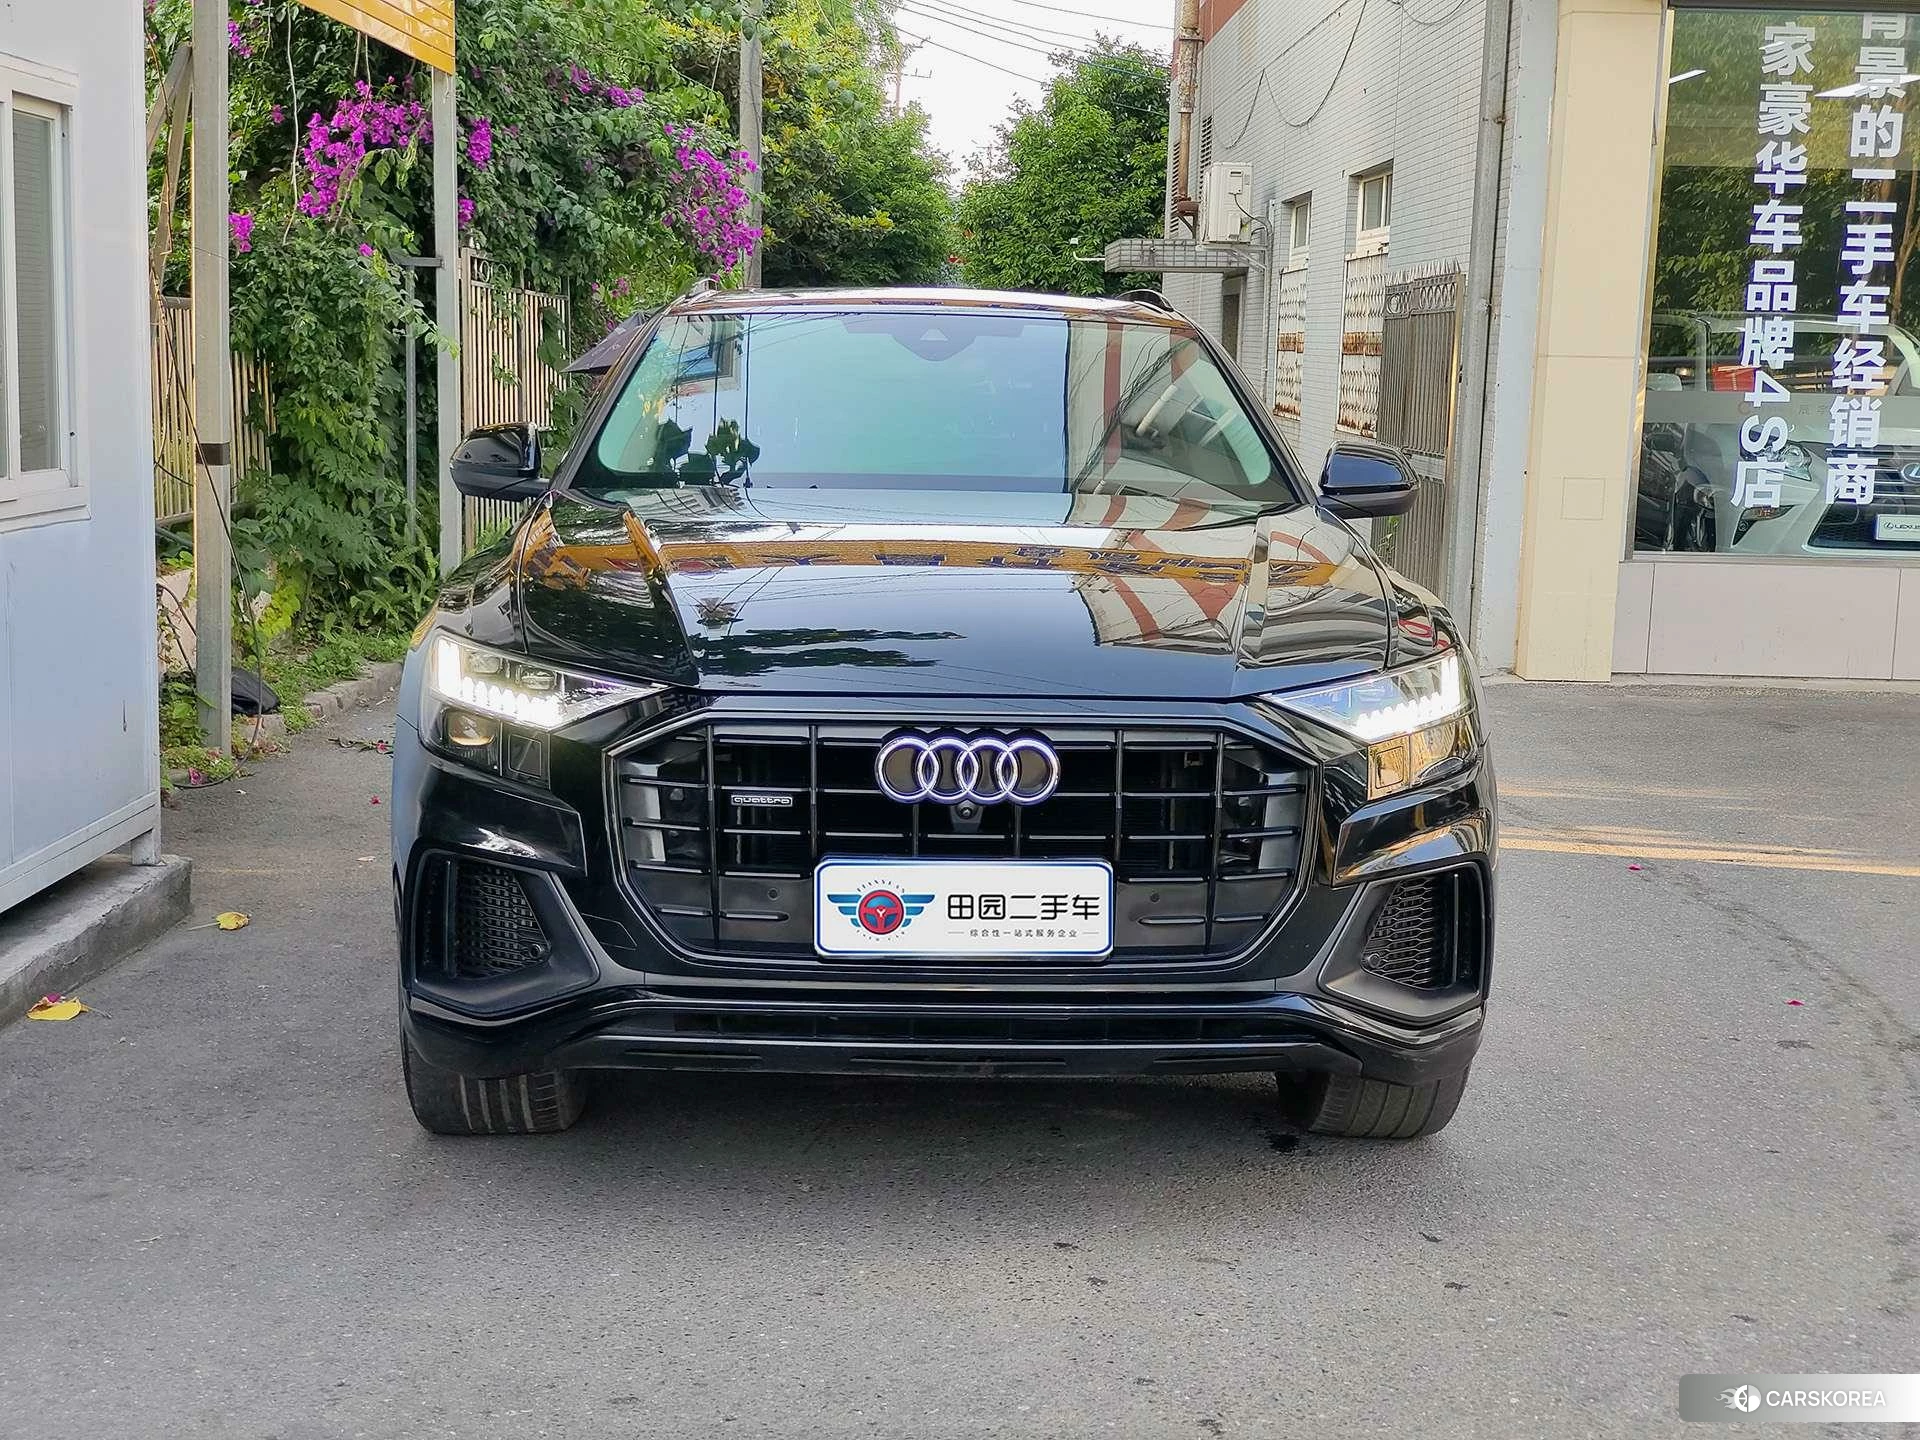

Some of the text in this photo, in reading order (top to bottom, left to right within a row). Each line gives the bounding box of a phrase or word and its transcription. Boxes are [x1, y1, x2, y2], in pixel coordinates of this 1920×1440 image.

[1730, 21, 1816, 509] 家豪华车品牌4S店
[733, 796, 791, 805] quattro
[947, 894, 1100, 920] 田园二手车
